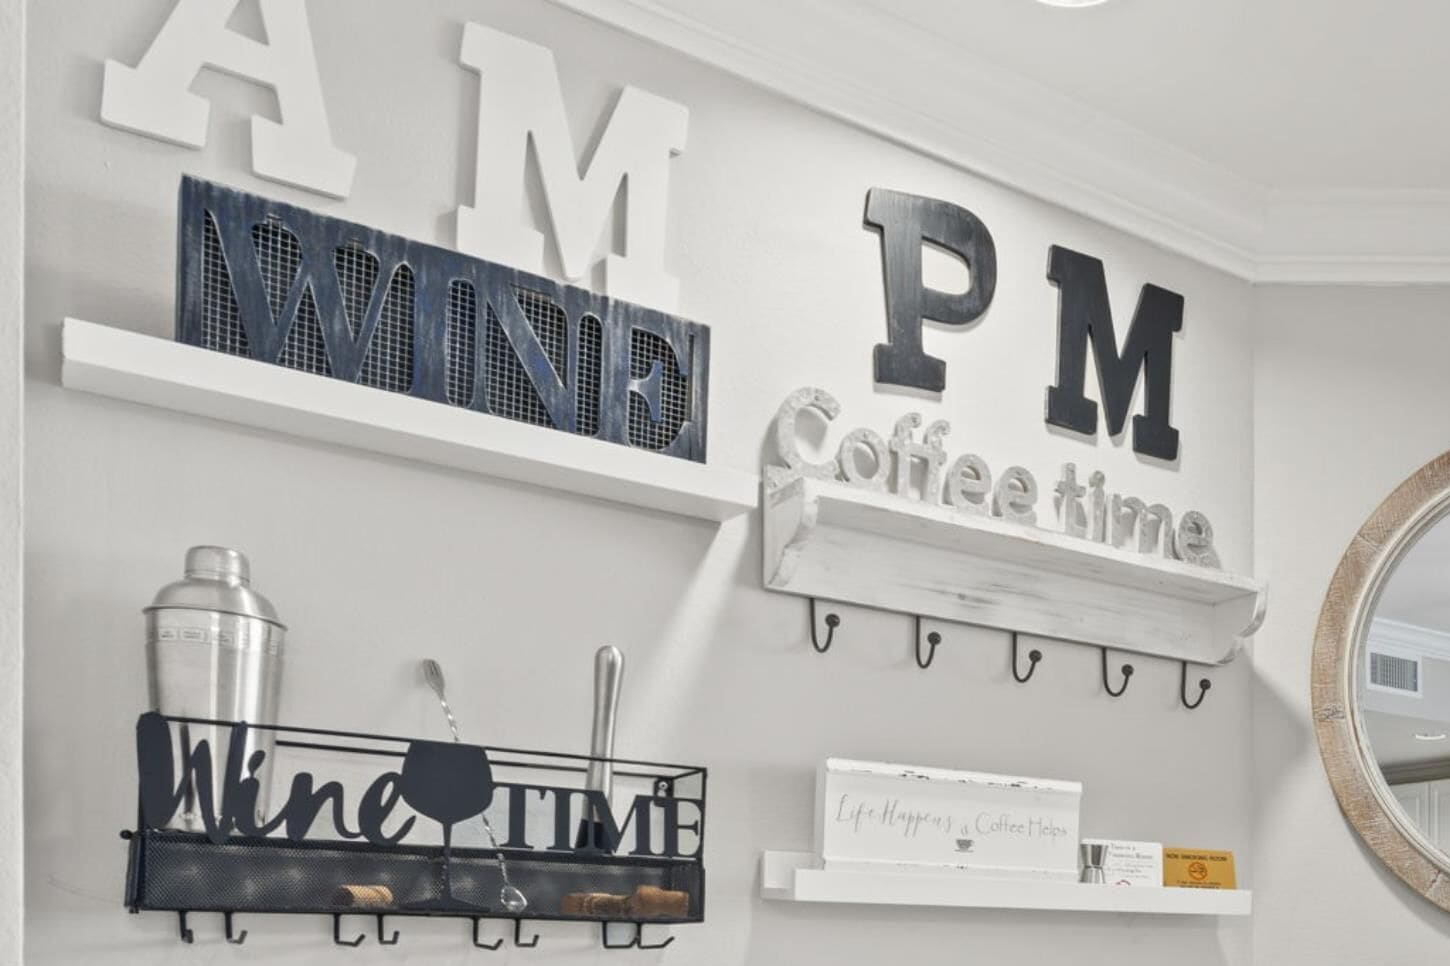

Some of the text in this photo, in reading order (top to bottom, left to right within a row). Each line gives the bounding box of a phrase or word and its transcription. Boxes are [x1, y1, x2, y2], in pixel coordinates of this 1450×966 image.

[202, 205, 694, 453] WINE
[776, 386, 1218, 567] Coffee time
[137, 711, 704, 858] Wine TIME
[835, 792, 1068, 842] Life Happens Coffee Helps
